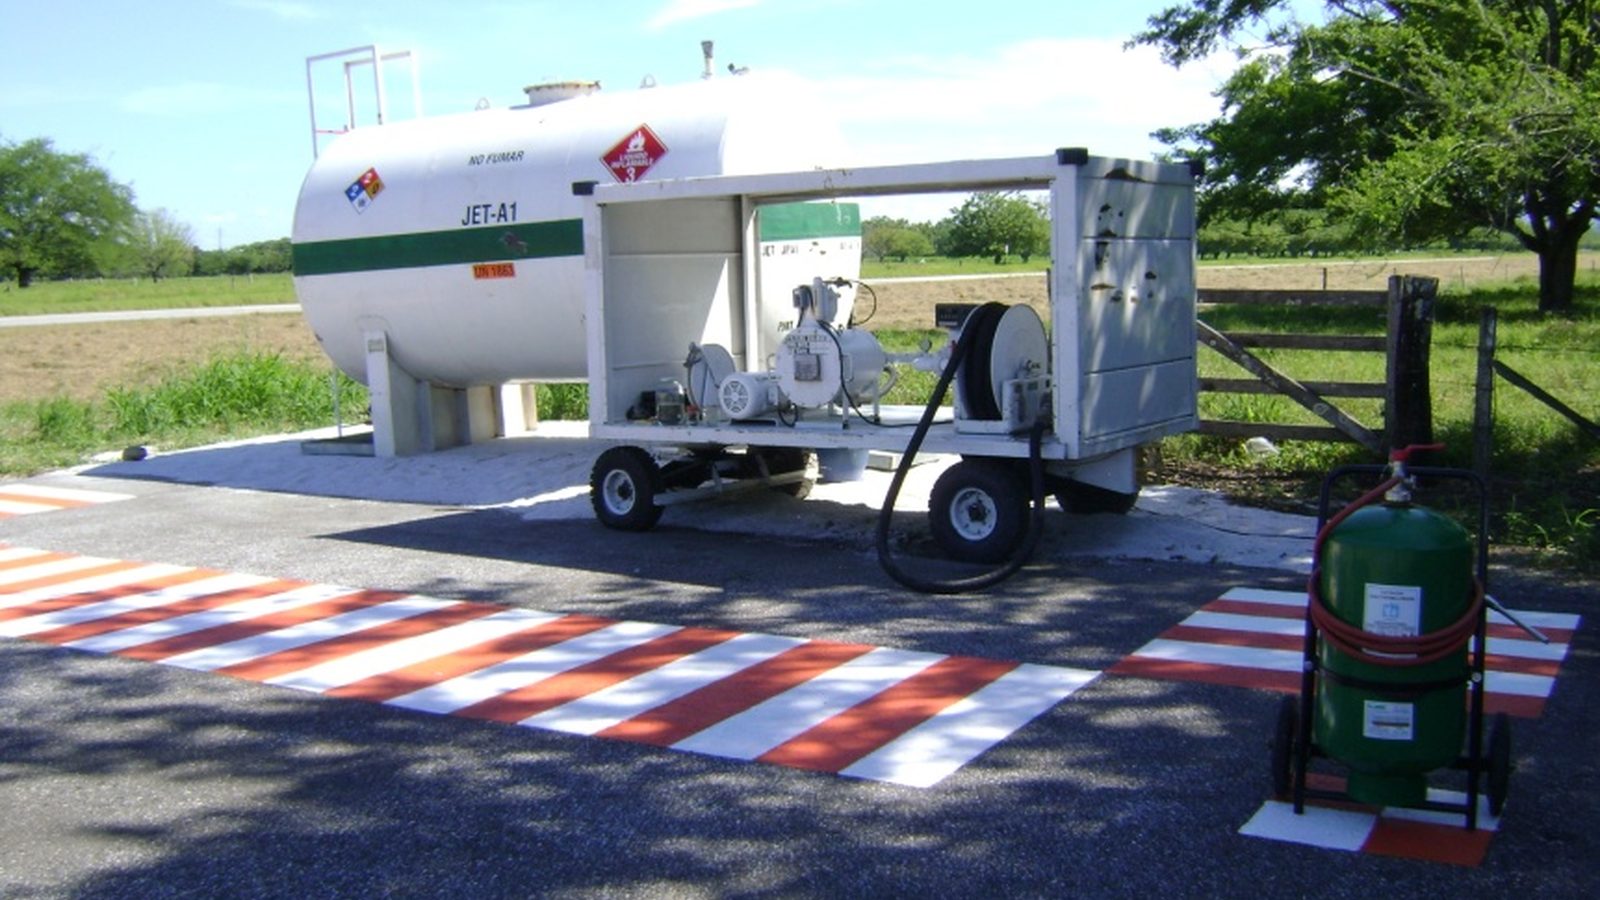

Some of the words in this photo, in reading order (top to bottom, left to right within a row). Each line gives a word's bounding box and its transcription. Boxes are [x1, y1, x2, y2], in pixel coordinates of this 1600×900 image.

[468, 155, 485, 166] NO
[487, 151, 524, 164] FUMAR
[626, 167, 636, 183] 3
[462, 202, 517, 226] JET-A1
[474, 266, 489, 278] UN
